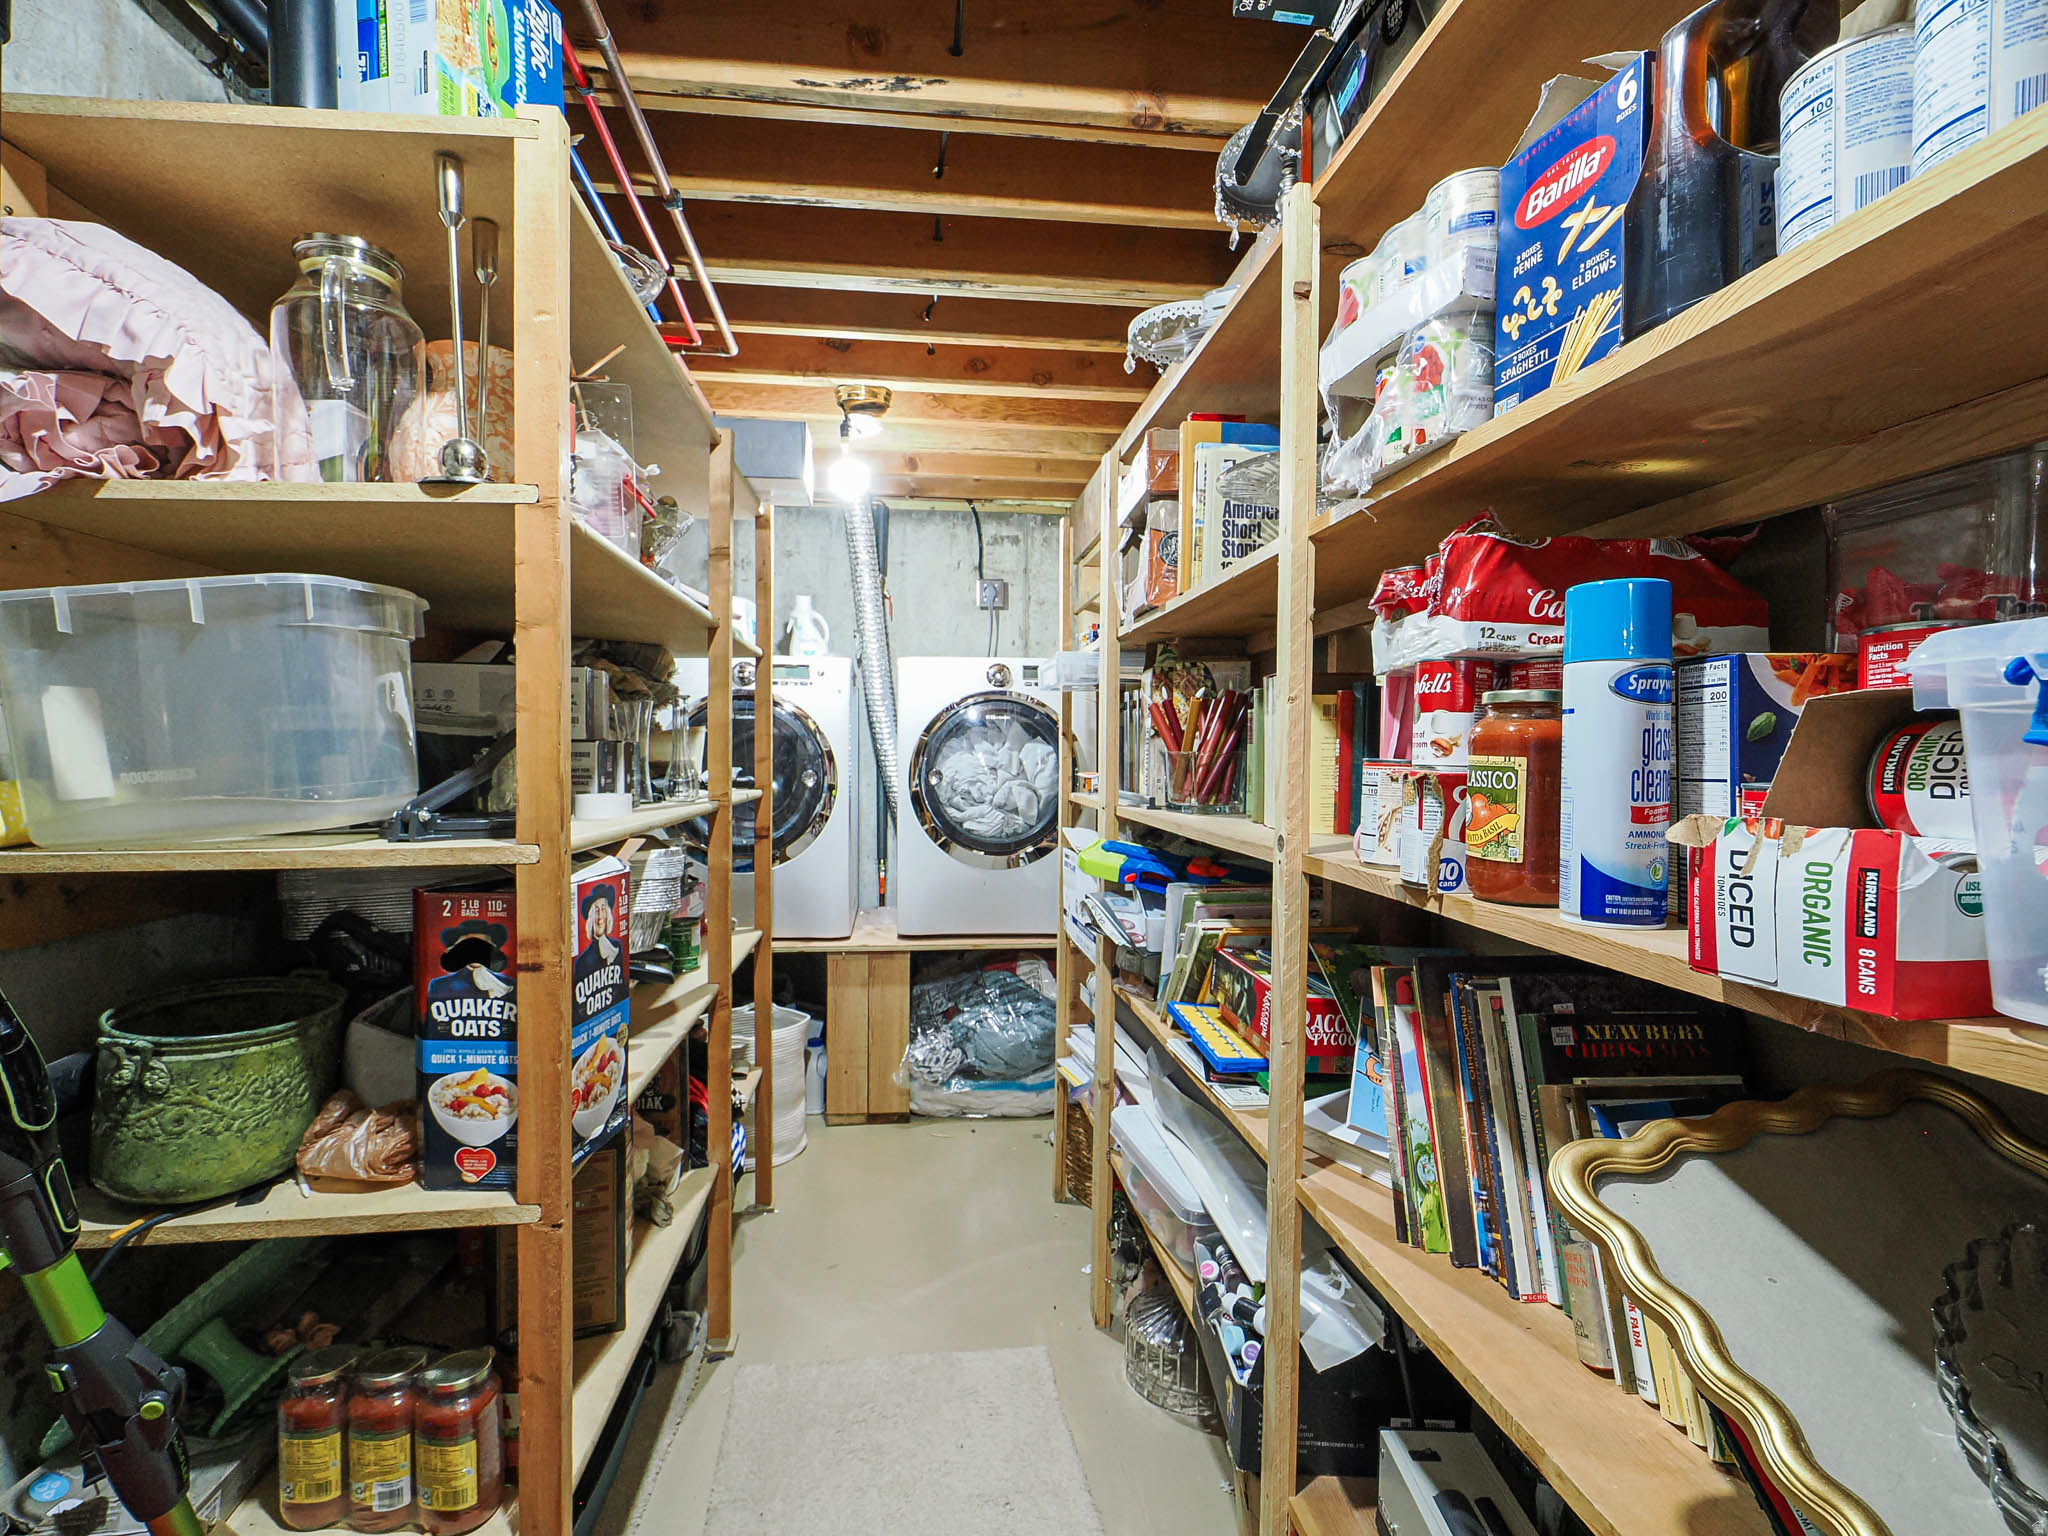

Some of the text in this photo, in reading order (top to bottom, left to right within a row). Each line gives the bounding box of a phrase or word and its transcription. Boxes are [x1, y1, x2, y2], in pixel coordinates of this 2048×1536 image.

[1803, 65, 1834, 88] Facts
[1617, 68, 1638, 110] 6
[1616, 102, 1637, 123] BOXES
[1810, 96, 1834, 117] 100
[1525, 149, 1603, 222] Barilla
[1513, 250, 1544, 278] PENNE
[1516, 242, 1542, 264] 2 BOXES
[1579, 248, 1610, 273] 2 BOXES
[1572, 255, 1617, 290] ELBOWS
[1512, 344, 1537, 364] 2 BOXES
[1500, 348, 1549, 384] SPAGHETTI
[1222, 519, 1262, 539] Short
[1480, 626, 1496, 640] 12
[1868, 642, 1903, 653] Nutrition
[1868, 652, 1889, 661] Facts
[1680, 663, 1728, 674] Nutrition Facts
[1710, 691, 1728, 701] 200
[1883, 735, 1911, 792] KIRKLAND
[1907, 735, 1943, 791] ORGANIC
[1368, 788, 1378, 796] 110
[1483, 822, 1502, 839] BASIL
[1438, 862, 1459, 882] 10
[621, 878, 626, 895] 2
[1717, 875, 1726, 917] TOMATOES
[442, 900, 507, 917] 2 5 LB 110+
[1728, 849, 1755, 948] DICED
[1864, 871, 1879, 937] KIRKLAND
[461, 908, 480, 917] BAGS
[1802, 861, 1833, 968] ORGANIC
[1858, 948, 1876, 957] 8
[575, 965, 622, 1004] QUAKER
[1858, 958, 1876, 995] CANS
[430, 998, 518, 1023] QUAKER
[586, 986, 613, 1016] OATS
[451, 1019, 501, 1037] OATS
[1584, 1023, 1705, 1040] NEWBERY
[1459, 1004, 1478, 1081] PINOCCHIO
[431, 1054, 518, 1065] QUICK 1-MINUTE OATS
[1630, 1317, 1643, 1348] FARM
